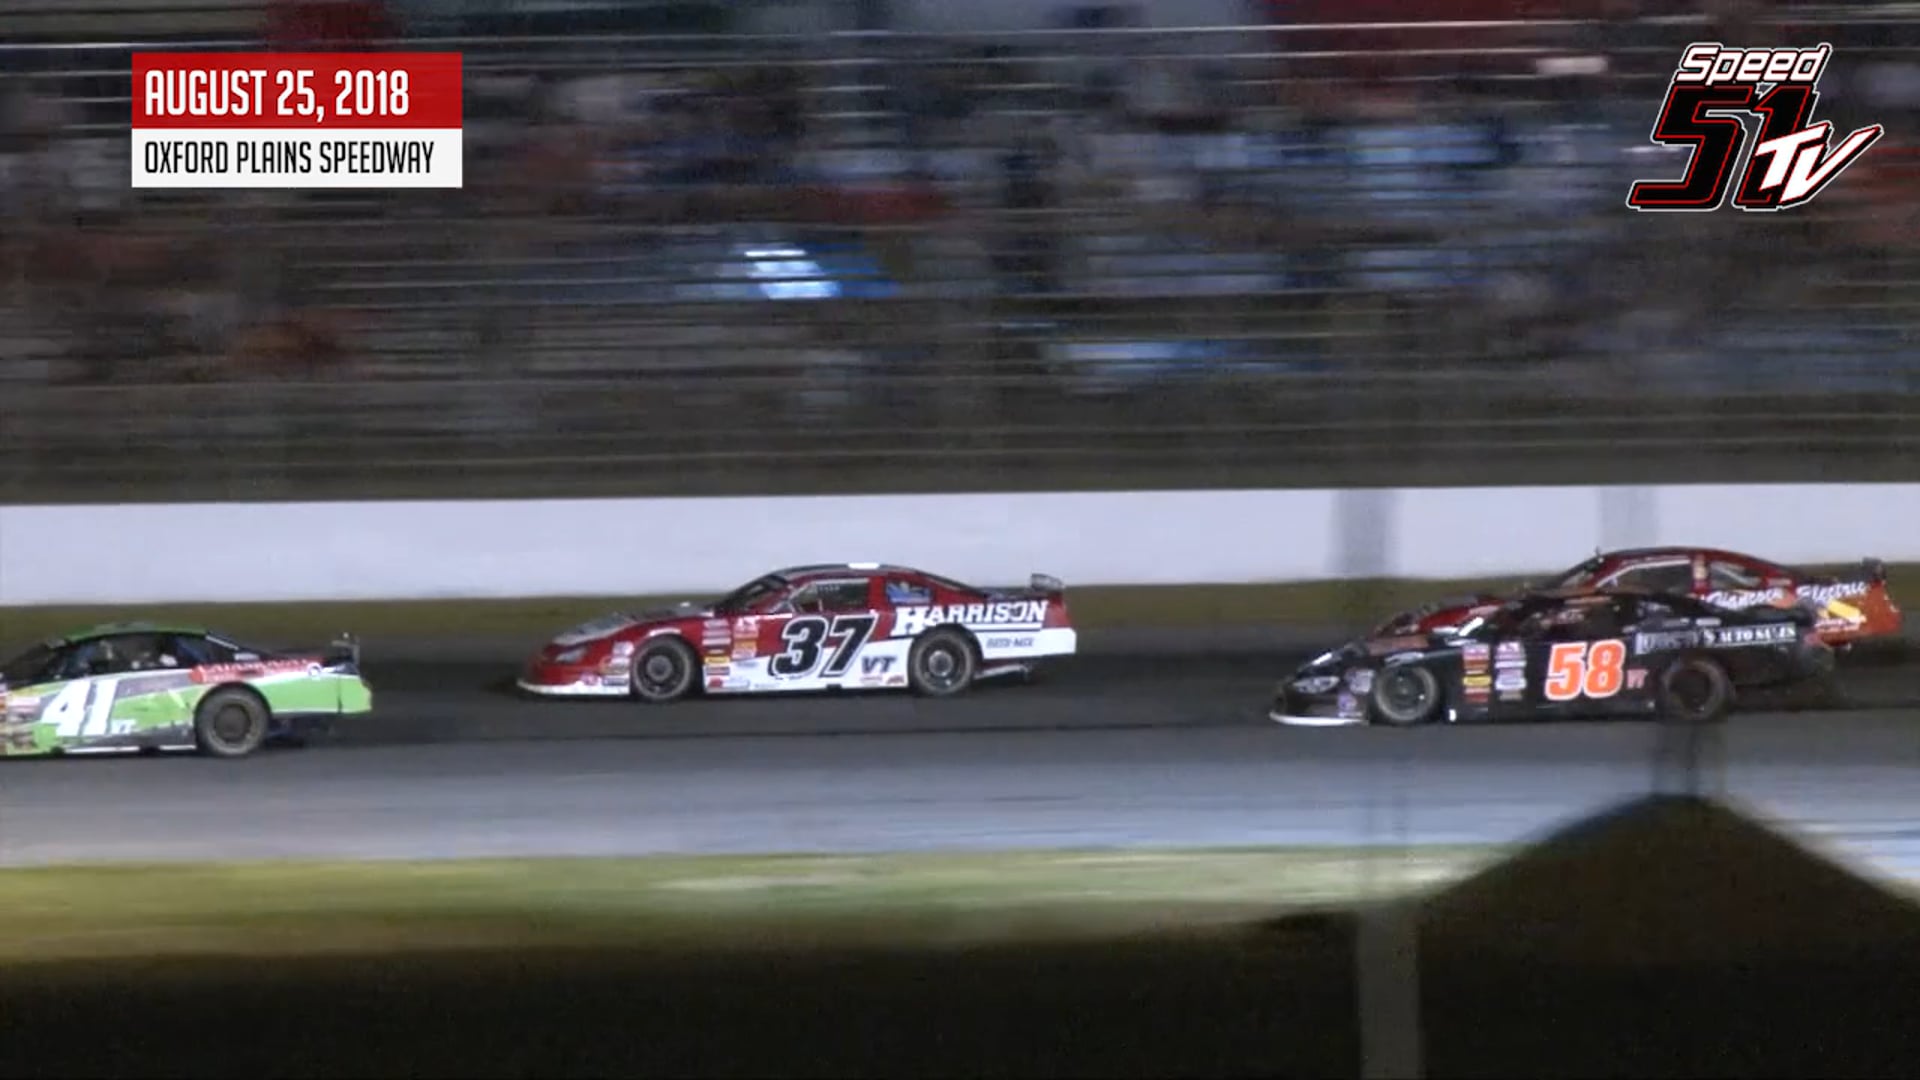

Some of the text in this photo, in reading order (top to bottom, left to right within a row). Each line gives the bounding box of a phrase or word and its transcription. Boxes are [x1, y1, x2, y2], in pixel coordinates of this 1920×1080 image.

[768, 614, 879, 679] 37
[889, 600, 1049, 637] HARRISON
[862, 656, 897, 673] VT
[1545, 639, 1626, 700] 58
[40, 679, 119, 736] 41
